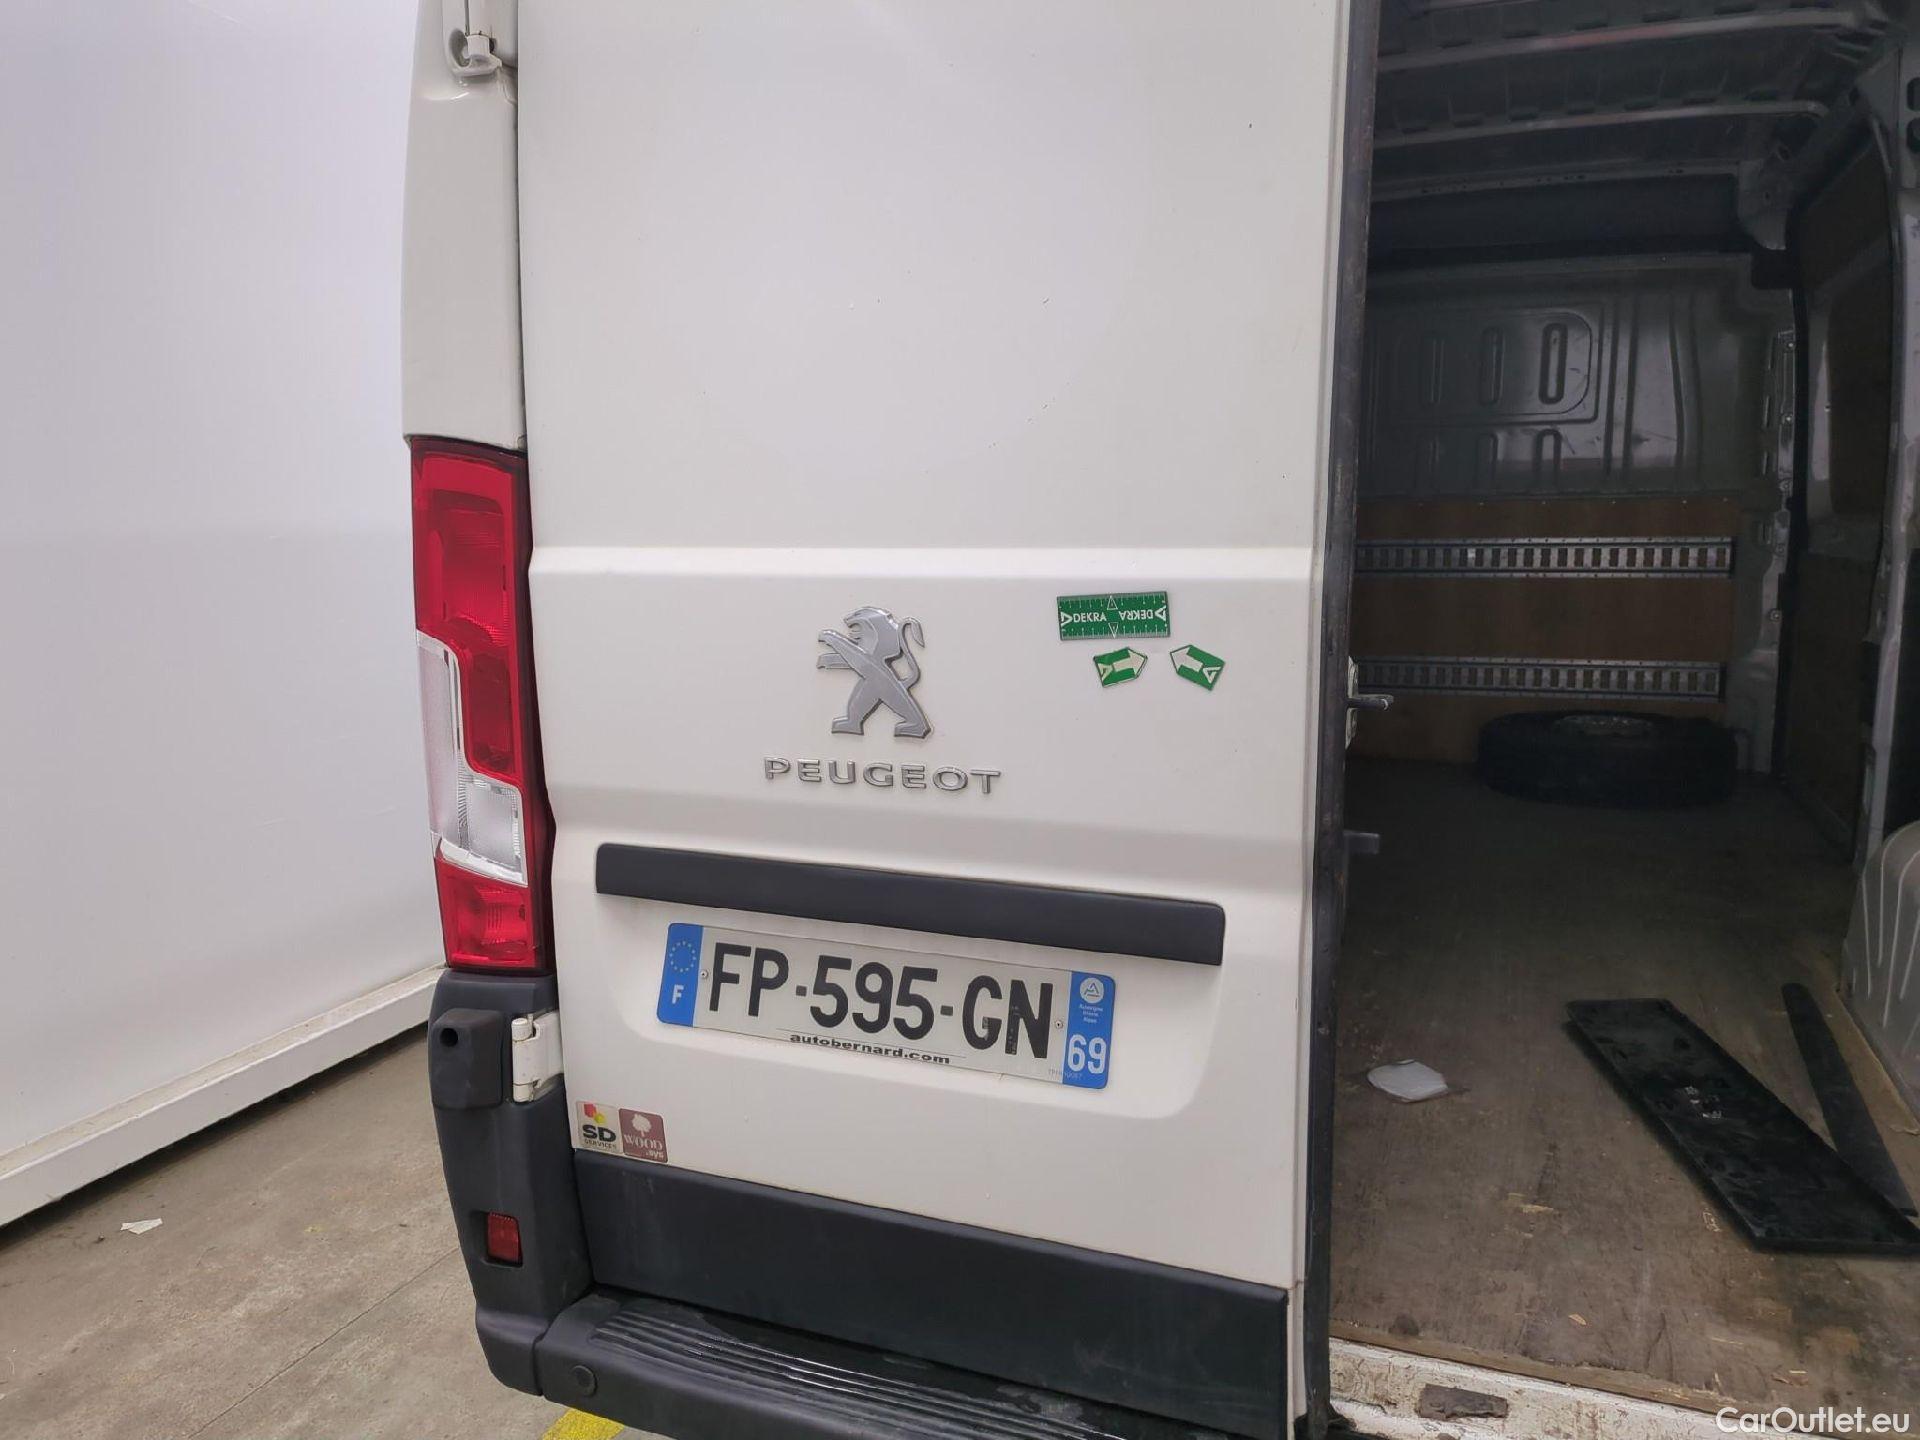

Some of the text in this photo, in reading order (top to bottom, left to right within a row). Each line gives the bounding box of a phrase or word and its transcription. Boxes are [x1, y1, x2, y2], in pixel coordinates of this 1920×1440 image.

[1073, 611, 1107, 623] DEKRA
[1118, 609, 1153, 621] DEKRA
[764, 757, 1001, 794] PEUGEOT
[671, 984, 684, 1005] F
[709, 942, 1054, 1059] FP-595-GN
[789, 1032, 951, 1065] autobernard.com
[1067, 1033, 1107, 1075] 69
[582, 1124, 617, 1143] SD
[624, 1134, 663, 1151] WOOD
